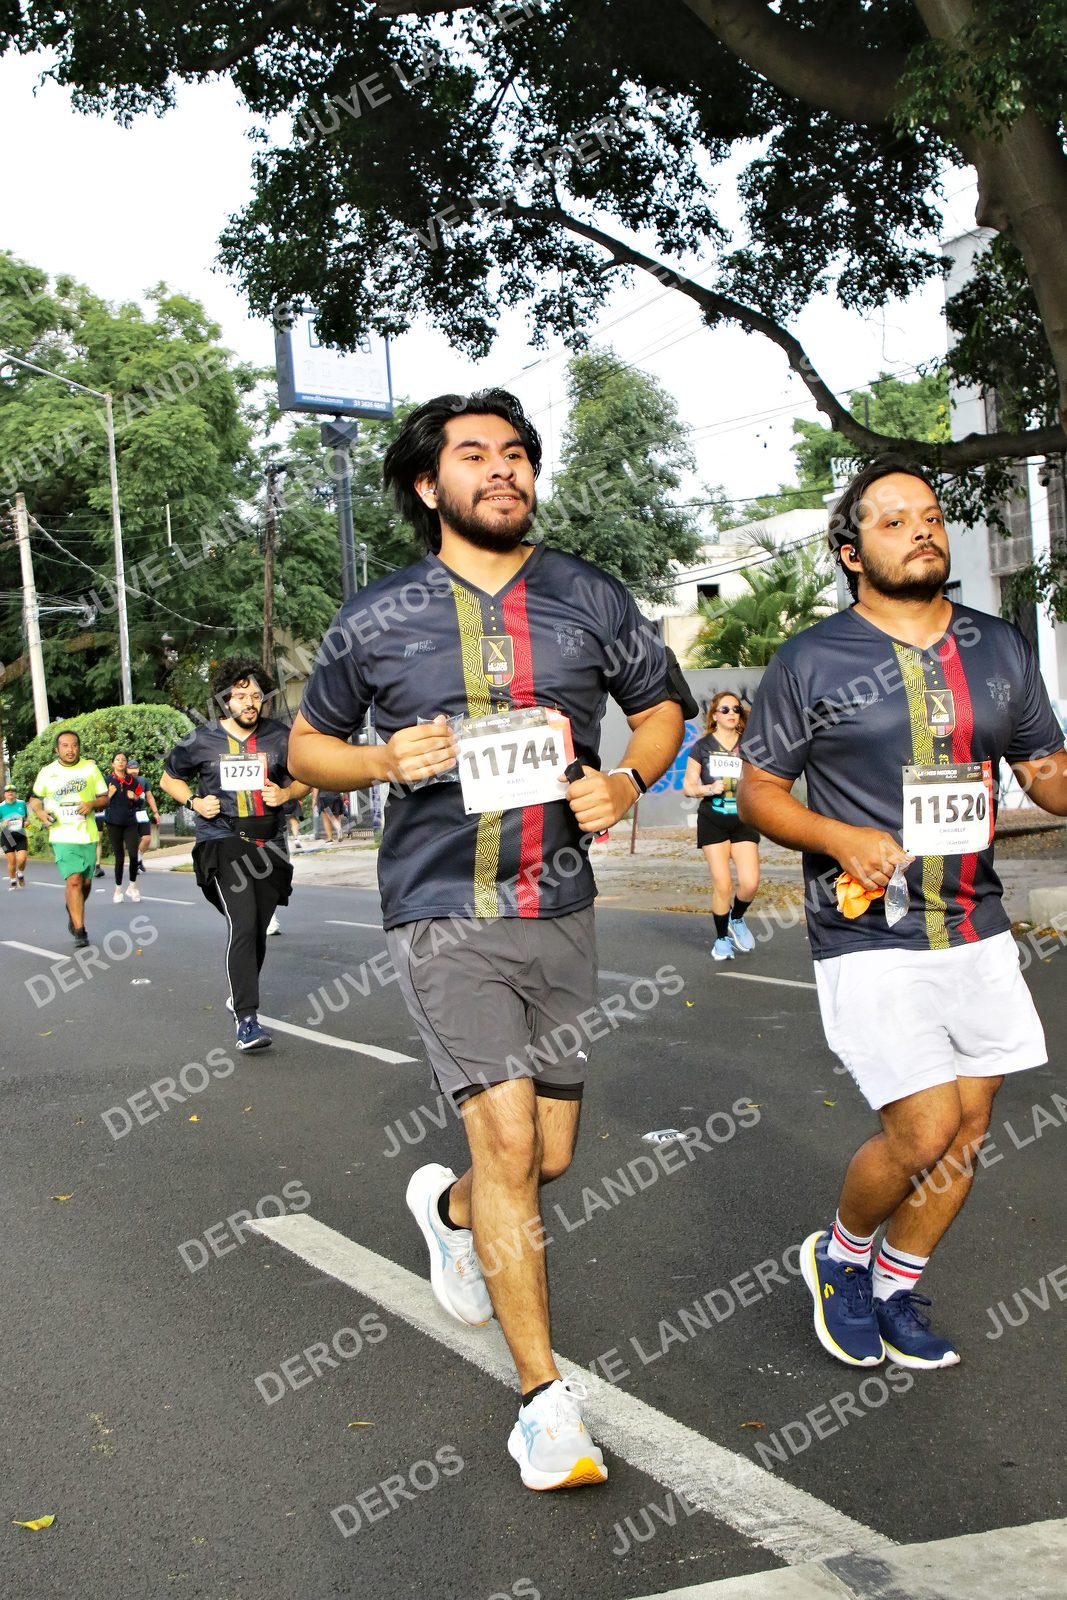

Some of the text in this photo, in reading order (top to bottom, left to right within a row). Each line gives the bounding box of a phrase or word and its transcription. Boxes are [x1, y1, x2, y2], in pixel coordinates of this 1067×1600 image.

[462, 736, 560, 780] 11744
[712, 759, 740, 769] 10649
[223, 765, 261, 778] 12757
[909, 792, 987, 825] 11520
